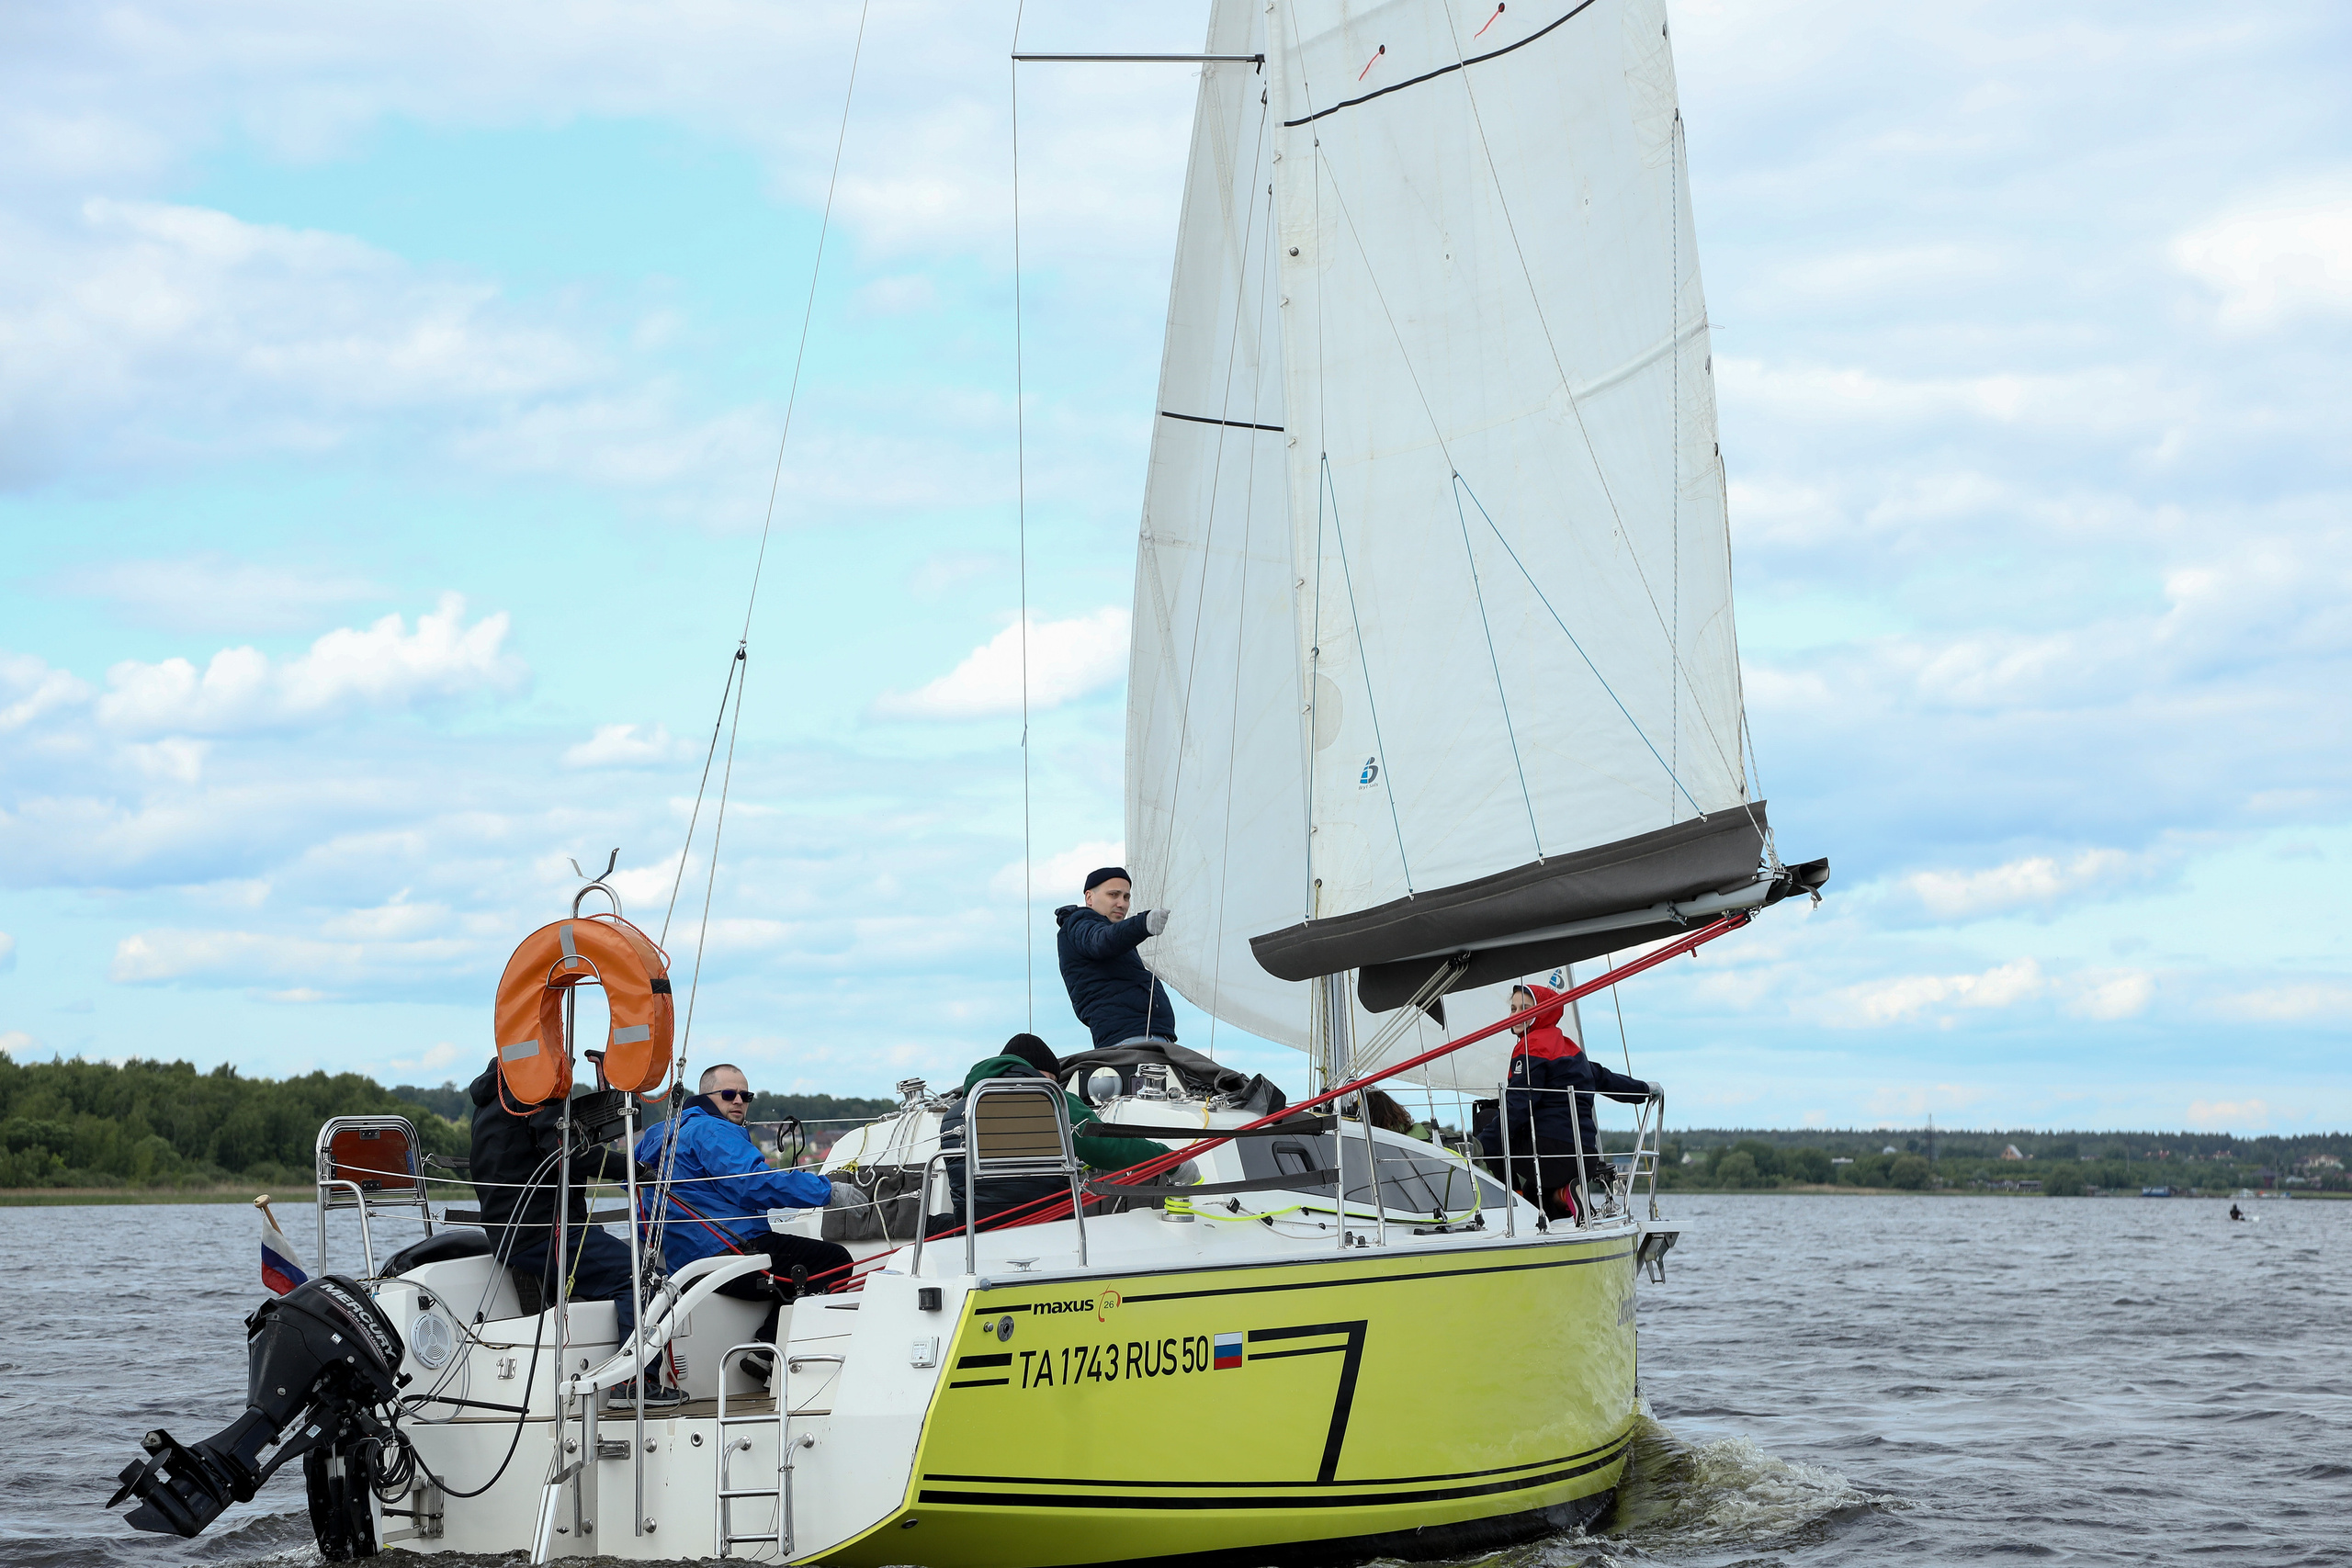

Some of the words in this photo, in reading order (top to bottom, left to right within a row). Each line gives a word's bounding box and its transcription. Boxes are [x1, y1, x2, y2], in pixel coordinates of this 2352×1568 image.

[319, 1283, 397, 1358] MERCURY
[1033, 1299, 1094, 1315] maxus
[1103, 1300, 1114, 1309] 26
[1019, 1349, 1054, 1389] TA
[1061, 1343, 1119, 1385] 1743
[1125, 1337, 1178, 1380] RUS
[1182, 1335, 1209, 1374] 50
